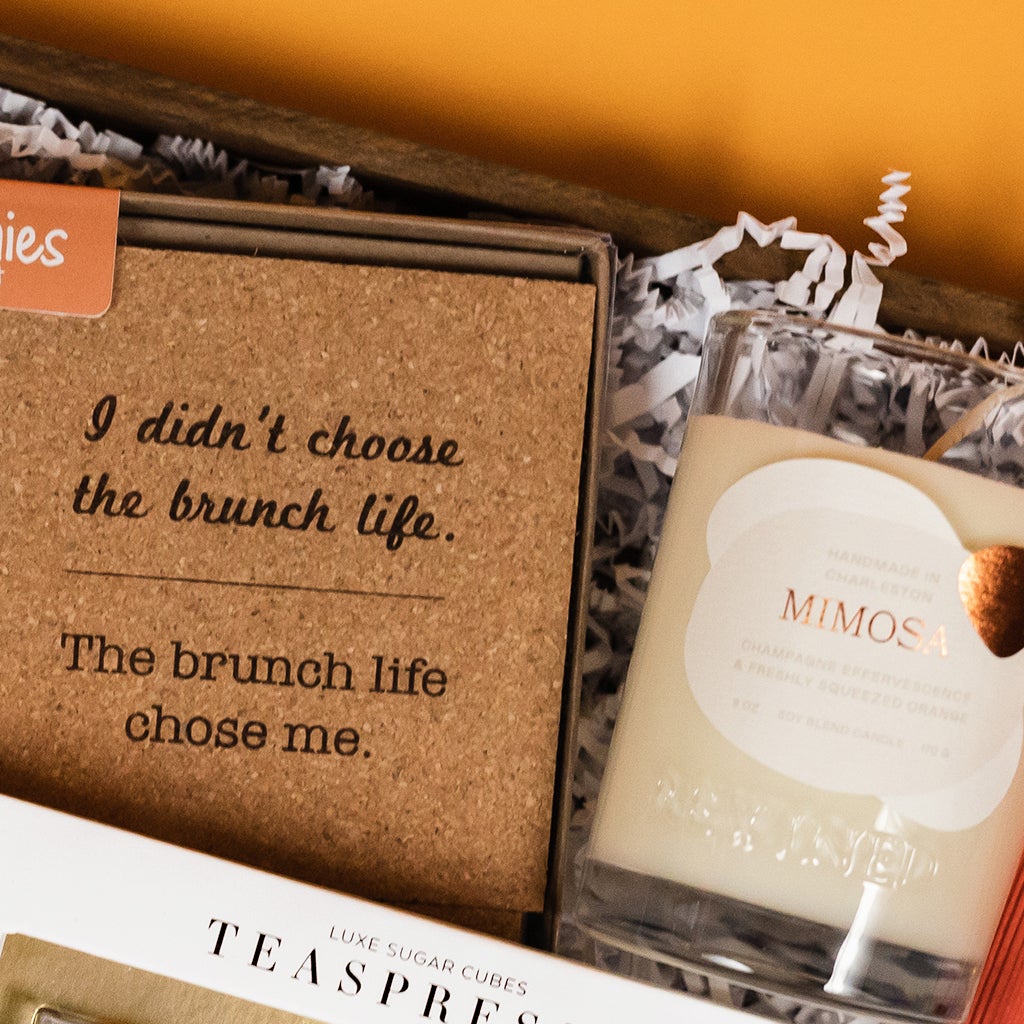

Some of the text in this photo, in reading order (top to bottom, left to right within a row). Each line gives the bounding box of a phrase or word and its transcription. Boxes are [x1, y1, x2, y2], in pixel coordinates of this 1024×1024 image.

[84, 394, 464, 467] I didn't choose
[72, 473, 456, 551] the brunch life.
[823, 568, 934, 605] CHARLESTON
[827, 548, 942, 585] HANDMADE IN
[779, 586, 952, 661] MIMOSA
[61, 632, 449, 697] The brunch life
[741, 639, 837, 675] CHAMPAGNE
[747, 661, 813, 689] FRESHLY
[907, 699, 969, 726] ORANGE
[125, 704, 372, 758] chose me.
[329, 925, 529, 998] LUXE SUGAR CUBES
